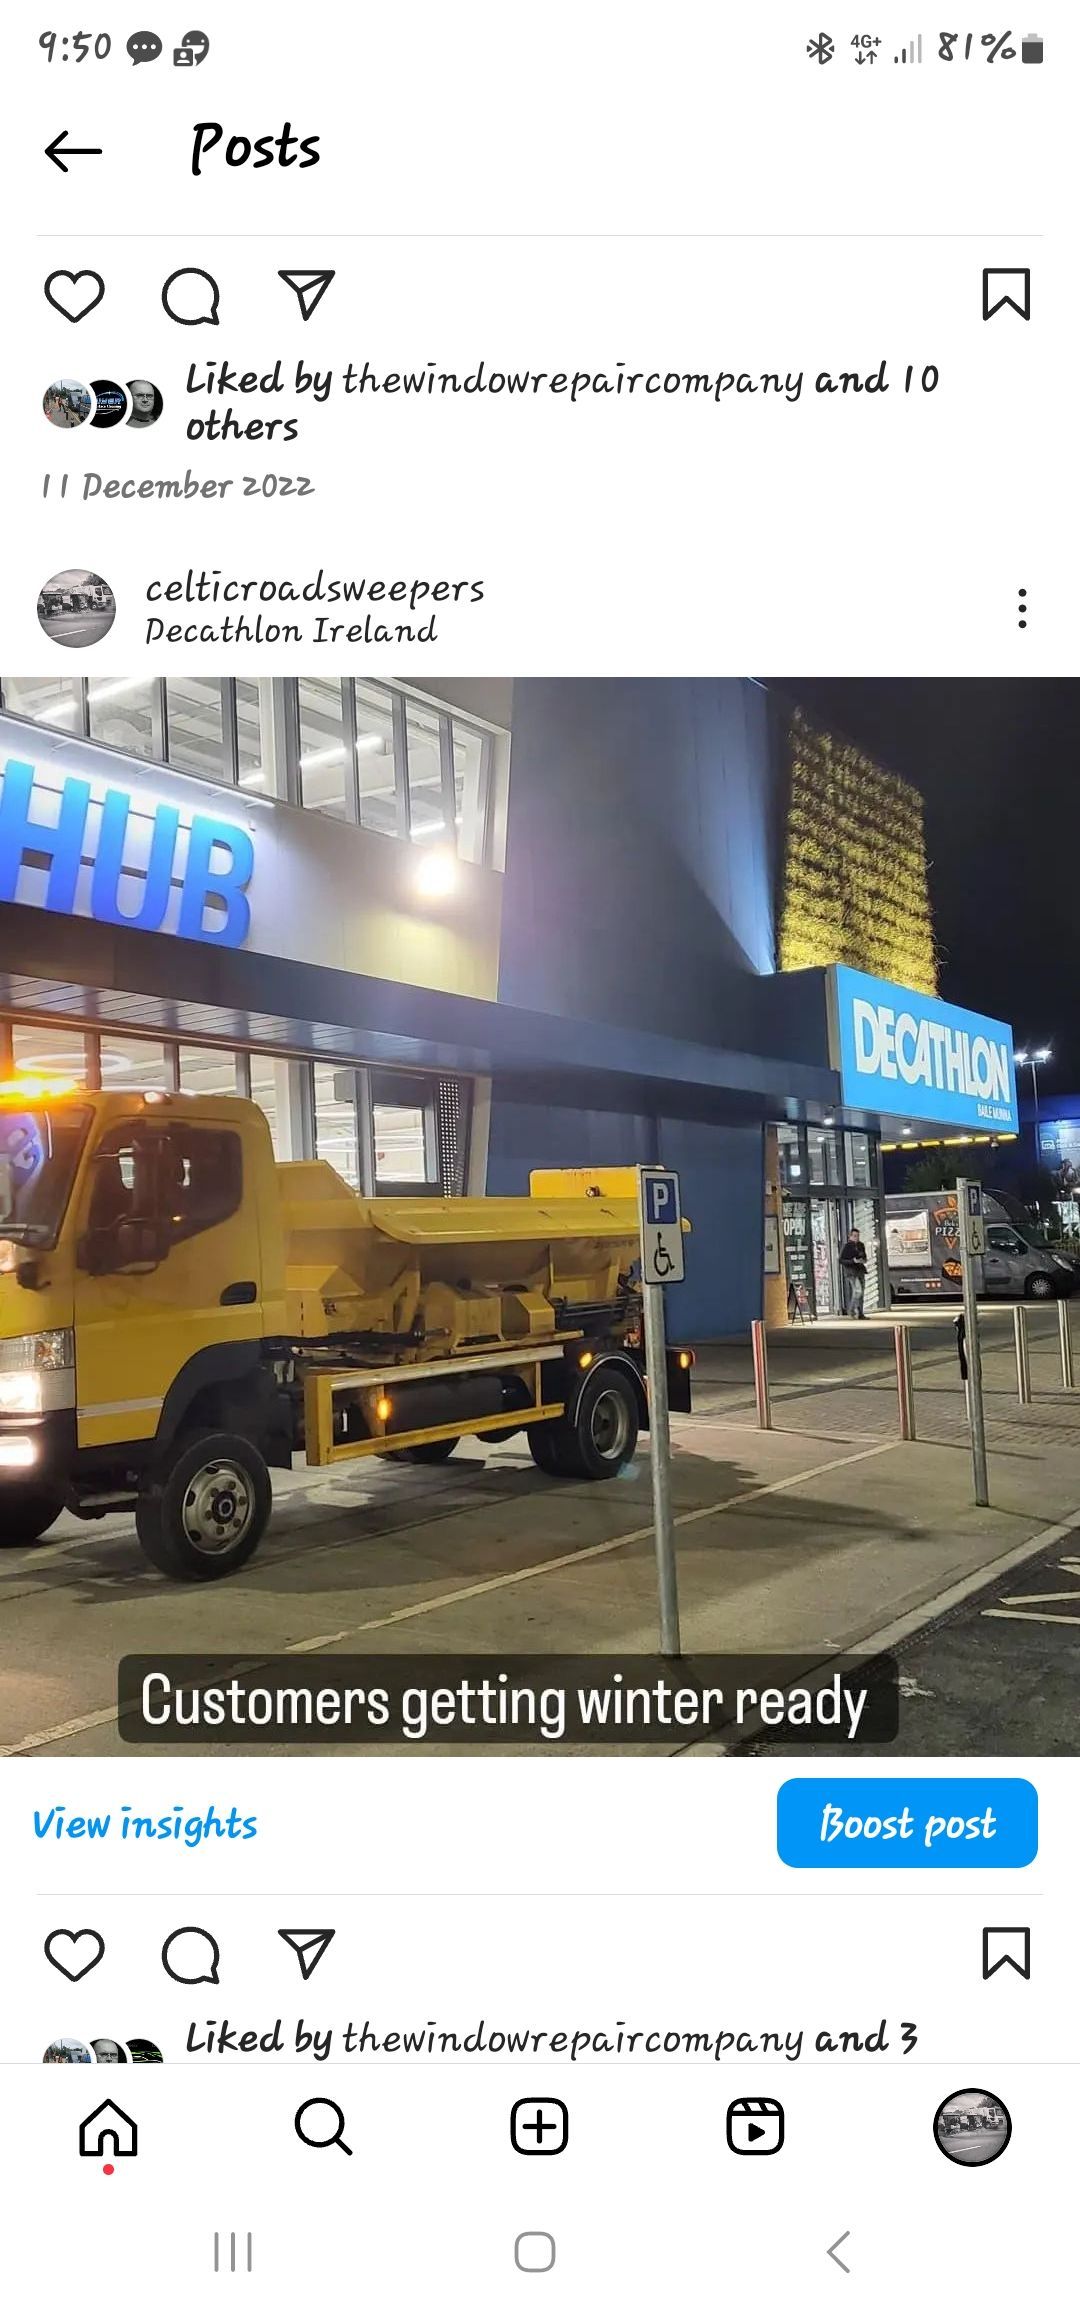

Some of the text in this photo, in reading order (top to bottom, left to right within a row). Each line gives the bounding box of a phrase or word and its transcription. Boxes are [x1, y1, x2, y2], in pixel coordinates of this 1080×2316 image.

[39, 31, 111, 62] 9:50
[851, 35, 881, 48] 4G+
[939, 31, 1016, 63] 81%
[192, 122, 320, 176] Posts
[187, 360, 938, 402] Liked by thewindowrepaircompany and 10
[187, 408, 297, 441] others
[44, 470, 315, 500] 11 December 2022
[147, 569, 483, 610] celticroadsweepers
[146, 615, 437, 644] Decathlon Ireland
[0, 759, 254, 947] HUB
[853, 998, 1010, 1103] DECATHLON
[653, 1183, 669, 1219] P
[935, 1227, 961, 1237] PIZZ
[34, 1806, 256, 1847] View insights
[820, 1805, 995, 1846] Boost post
[187, 2019, 918, 2061] Liked by thewindowrepaircompany and 3
